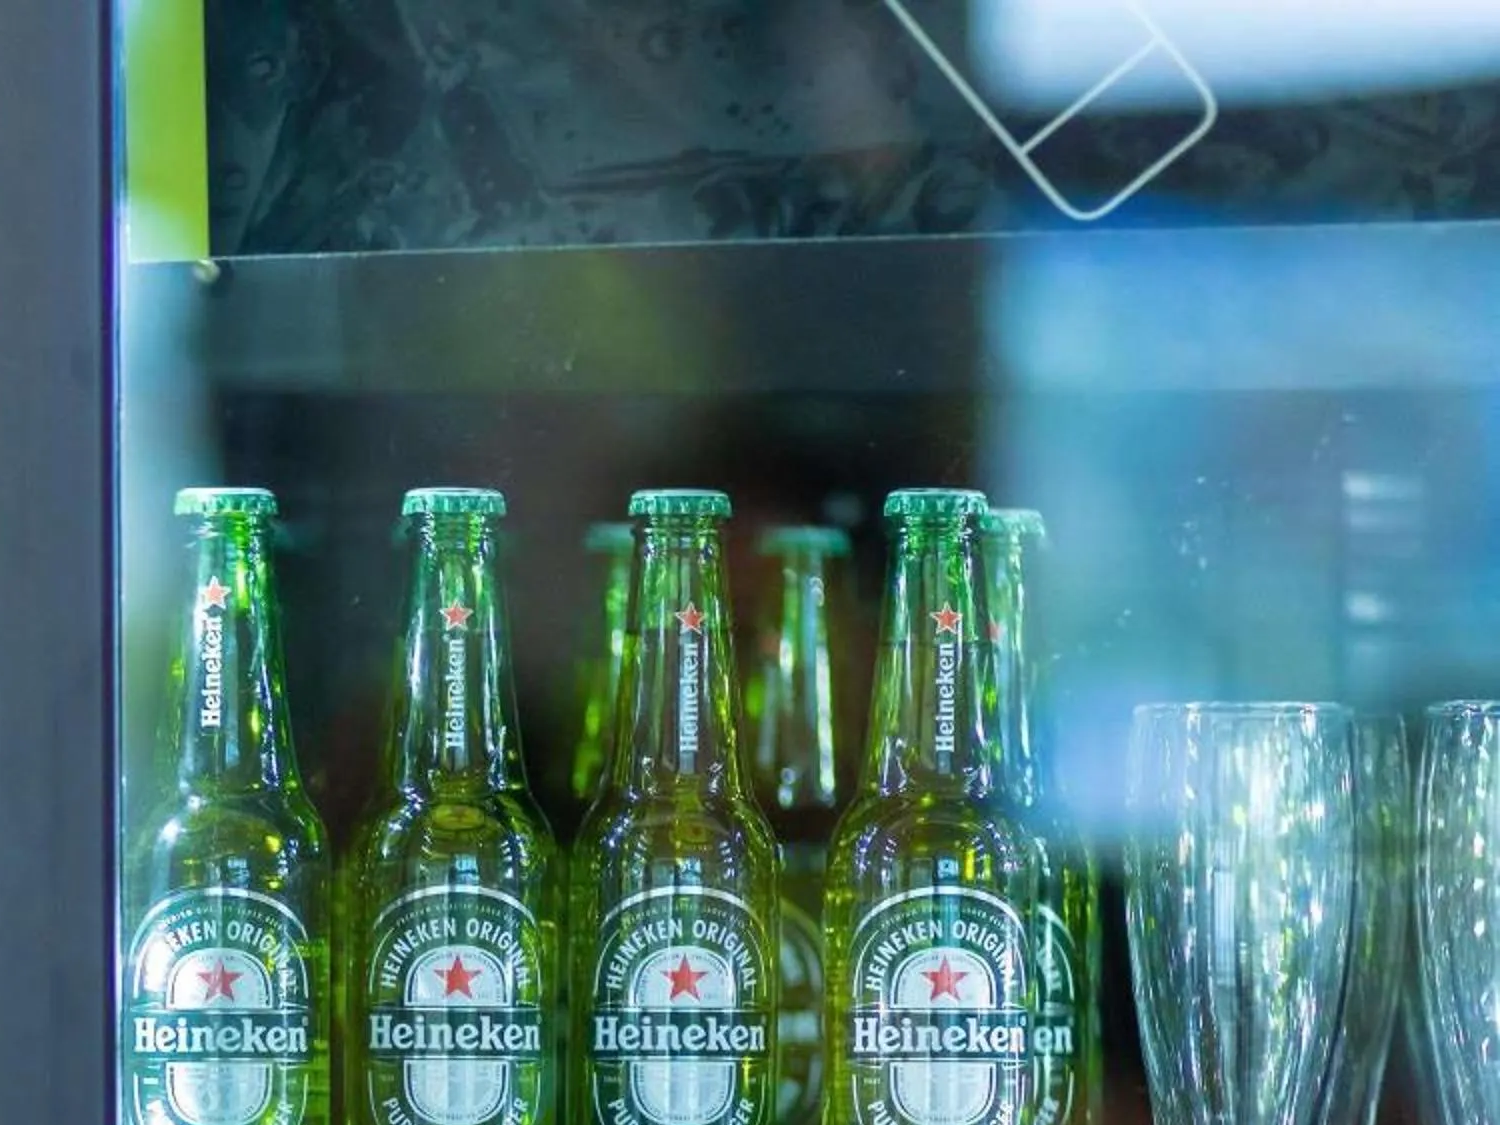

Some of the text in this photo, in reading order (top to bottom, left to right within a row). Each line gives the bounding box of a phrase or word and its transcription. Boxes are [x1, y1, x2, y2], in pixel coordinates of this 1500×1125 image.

[201, 615, 222, 728] Heineken
[445, 638, 465, 749] Heineken
[679, 643, 698, 752] Heineken
[935, 643, 954, 752] Heineken
[380, 918, 531, 989] HEINEKEN ORIGINAL
[606, 918, 757, 990] HEINEKEN ORIGINAL
[866, 919, 943, 991] HEINEKEN
[134, 1017, 308, 1053] Heineken
[369, 1015, 541, 1050] Heineken
[594, 1016, 765, 1051] Heineken
[853, 1017, 1025, 1053] Heineken
